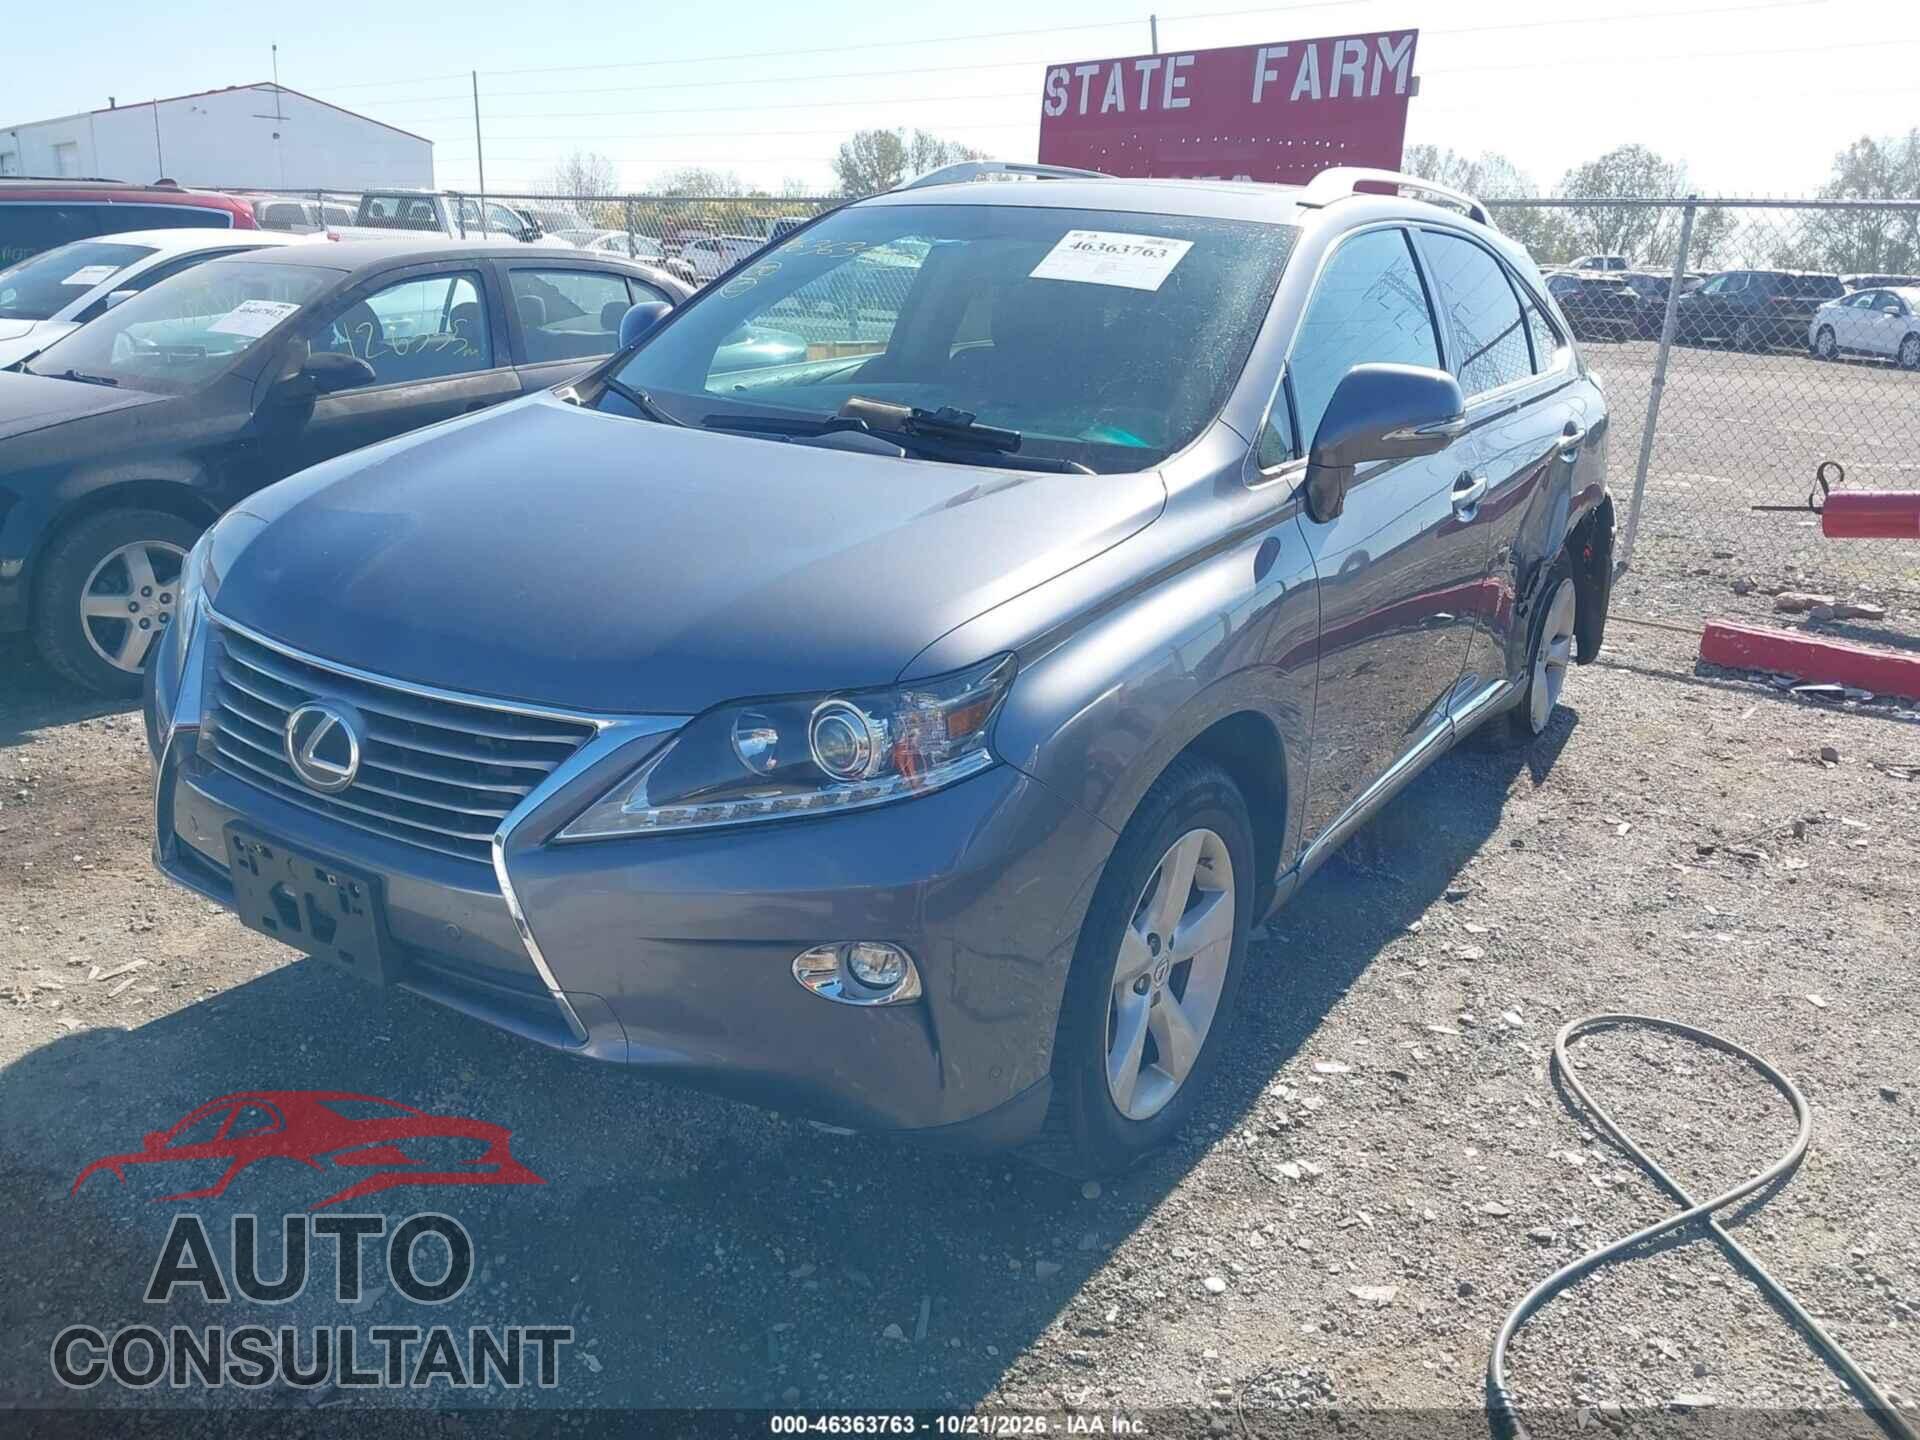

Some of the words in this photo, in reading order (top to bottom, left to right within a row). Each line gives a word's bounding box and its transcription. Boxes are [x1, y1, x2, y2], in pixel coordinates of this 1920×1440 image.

[1044, 54, 1195, 117] STATE
[1252, 34, 1414, 103] FARM
[1069, 240, 1168, 259] 46363763
